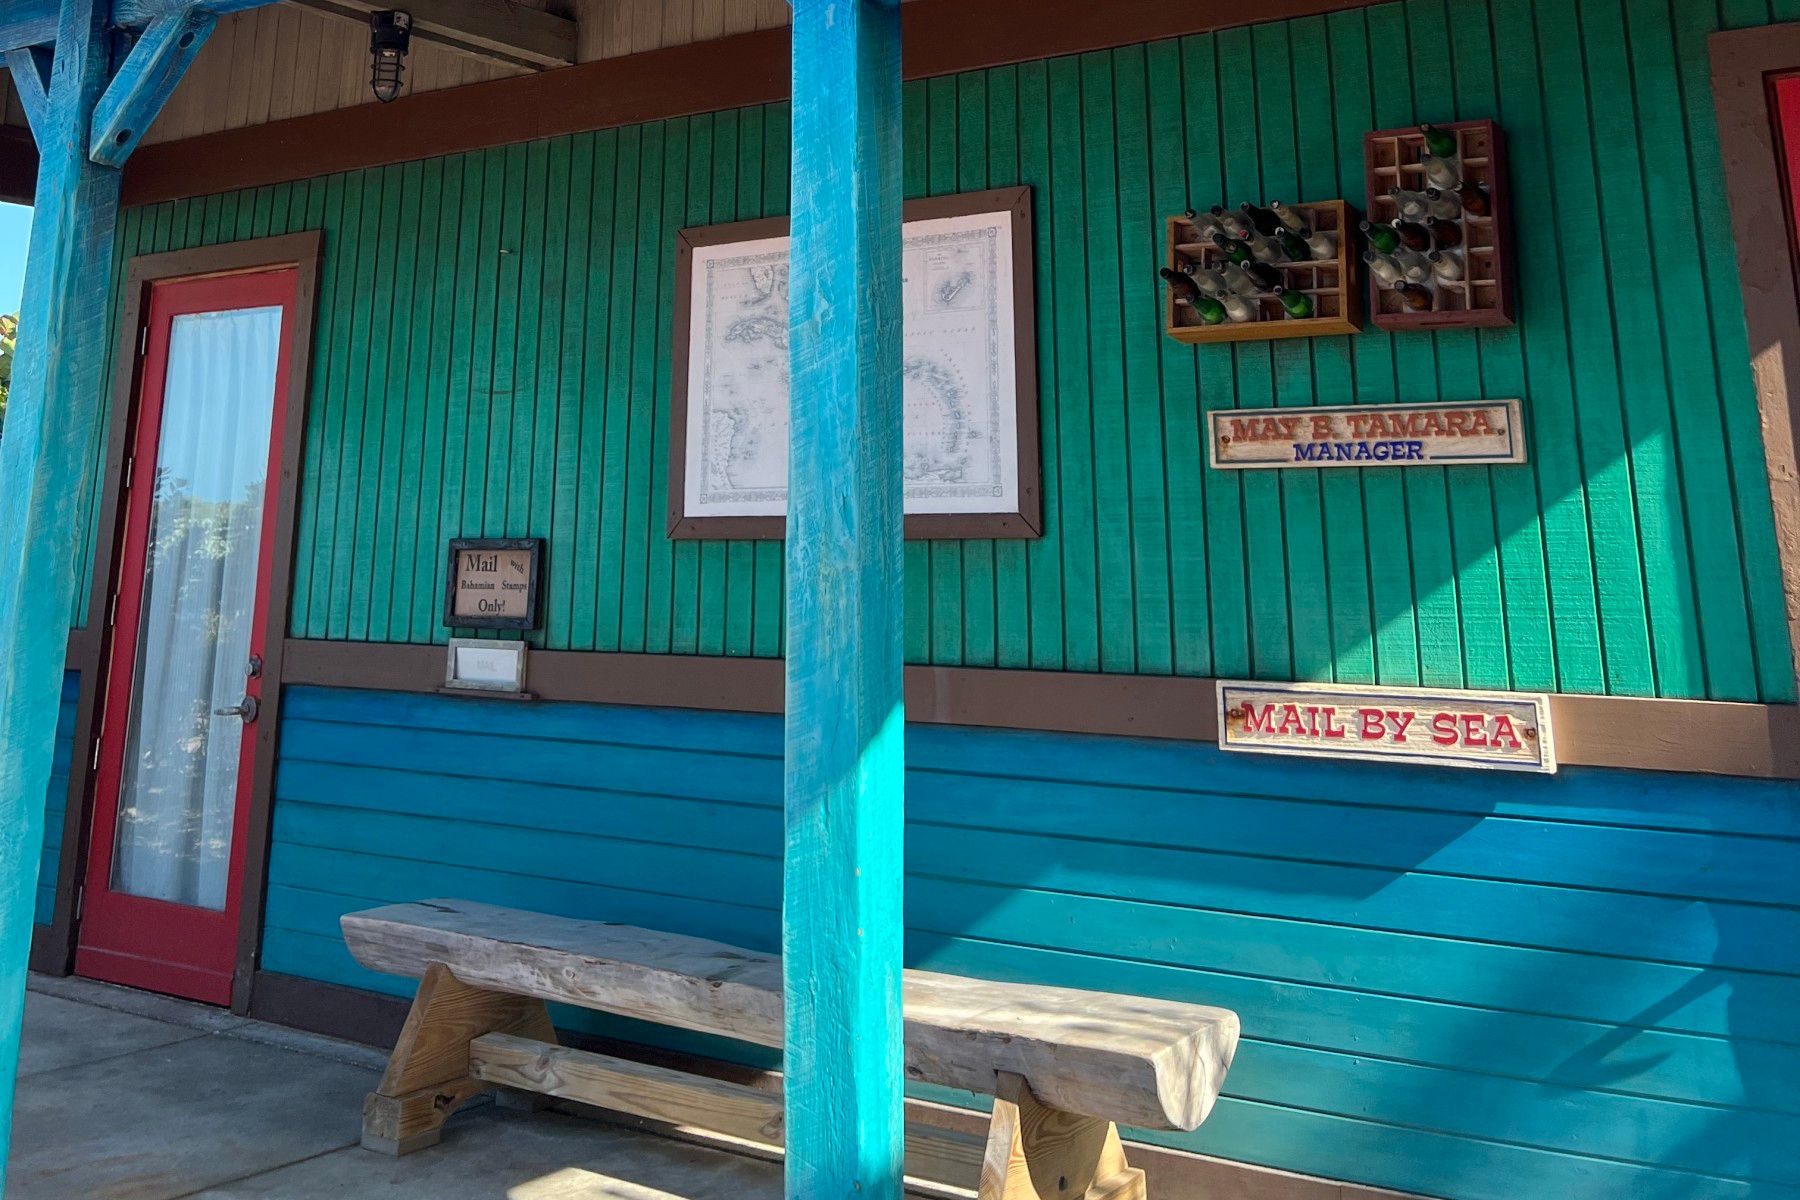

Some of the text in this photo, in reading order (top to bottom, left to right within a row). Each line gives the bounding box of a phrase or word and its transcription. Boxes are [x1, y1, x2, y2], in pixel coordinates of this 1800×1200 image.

[1231, 416, 1303, 442] MAY
[1347, 411, 1497, 439] TAMARA
[1293, 440, 1424, 462] MANAGER
[466, 554, 525, 574] Mail with
[461, 580, 528, 593] Bahamian Stamps
[478, 598, 506, 616] Only!
[1241, 702, 1522, 747] MAIL BY SEA
